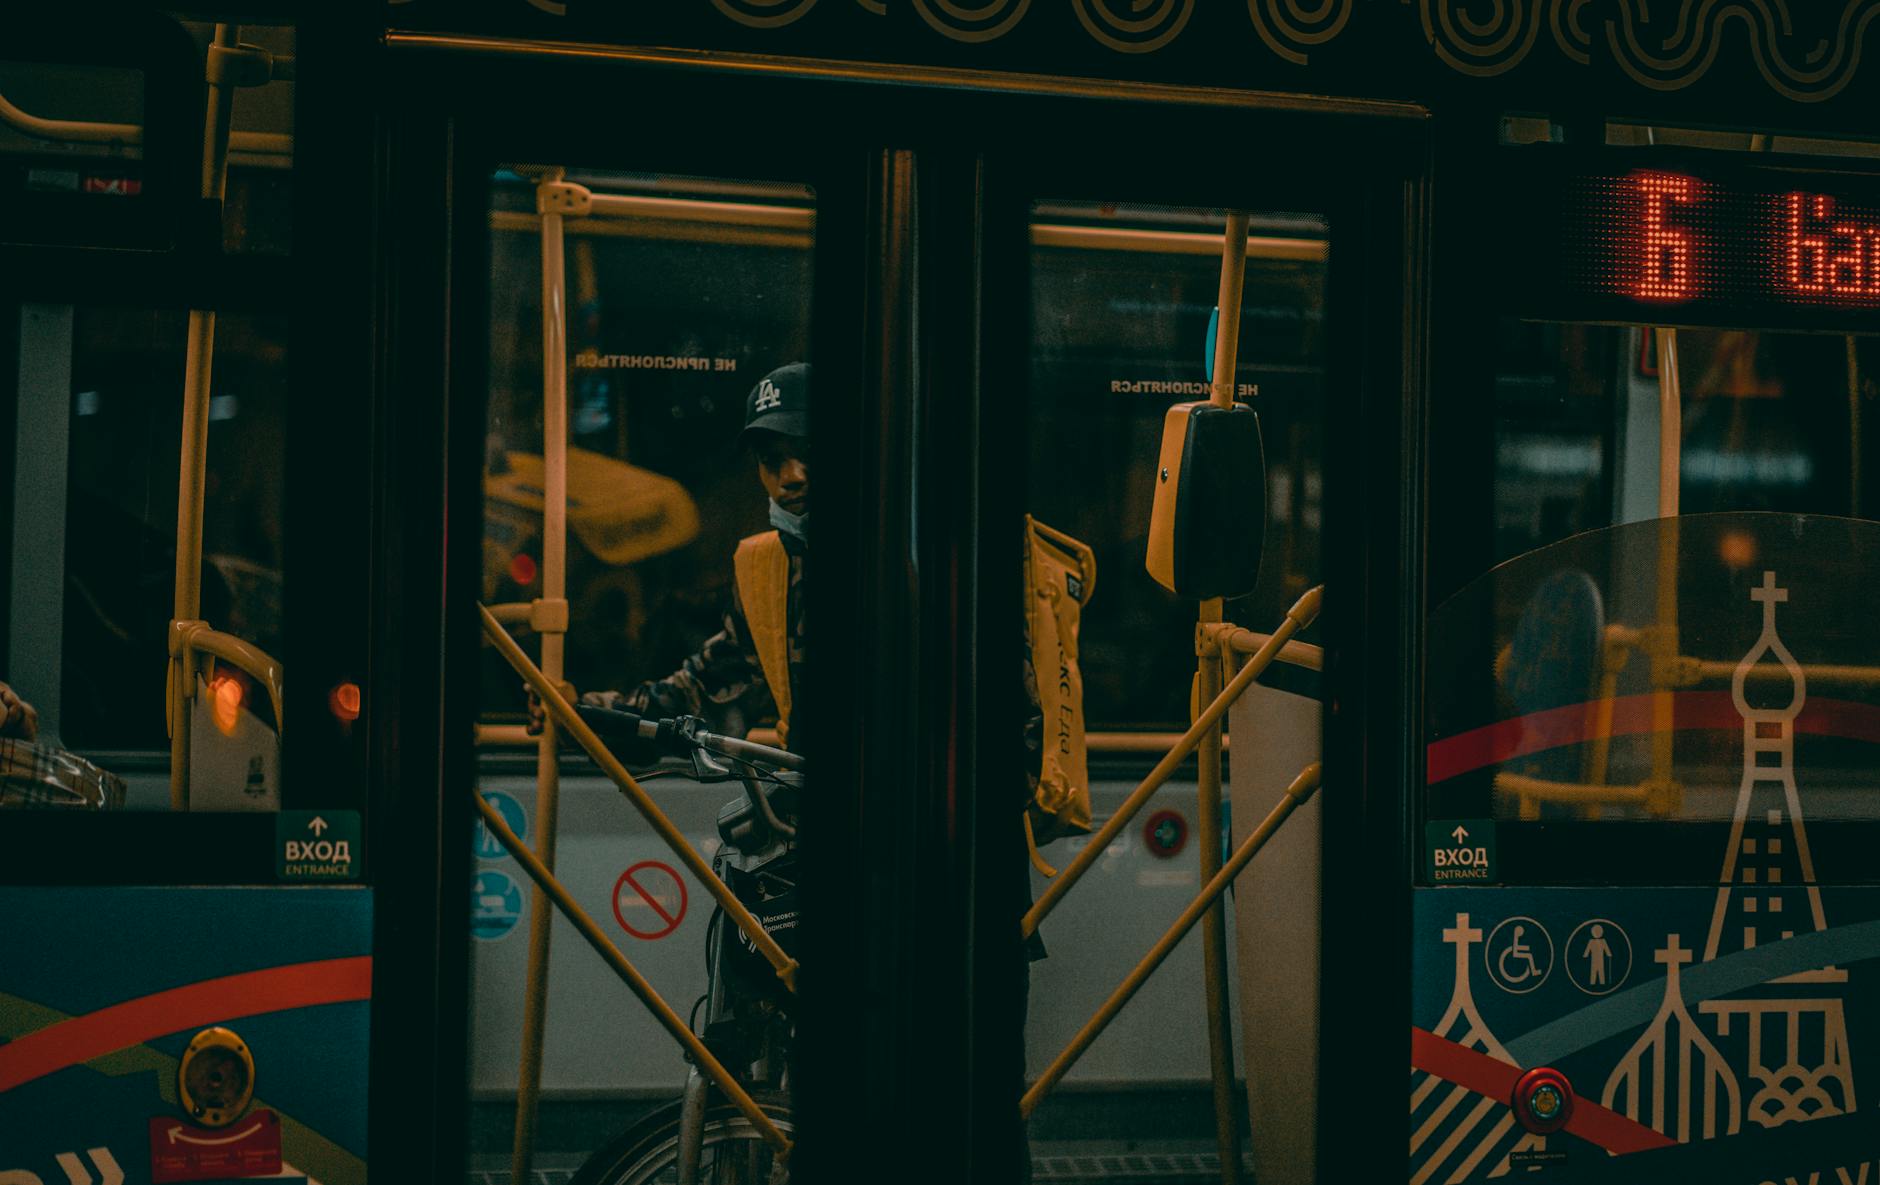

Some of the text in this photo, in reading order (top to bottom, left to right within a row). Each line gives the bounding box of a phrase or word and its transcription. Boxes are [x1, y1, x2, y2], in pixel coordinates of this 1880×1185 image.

[755, 379, 782, 413] LA
[285, 839, 352, 865] ВХОД
[1434, 847, 1489, 868] ВХОД
[285, 863, 350, 877] ENTRANCE
[1434, 868, 1488, 880] ENTRANCE
